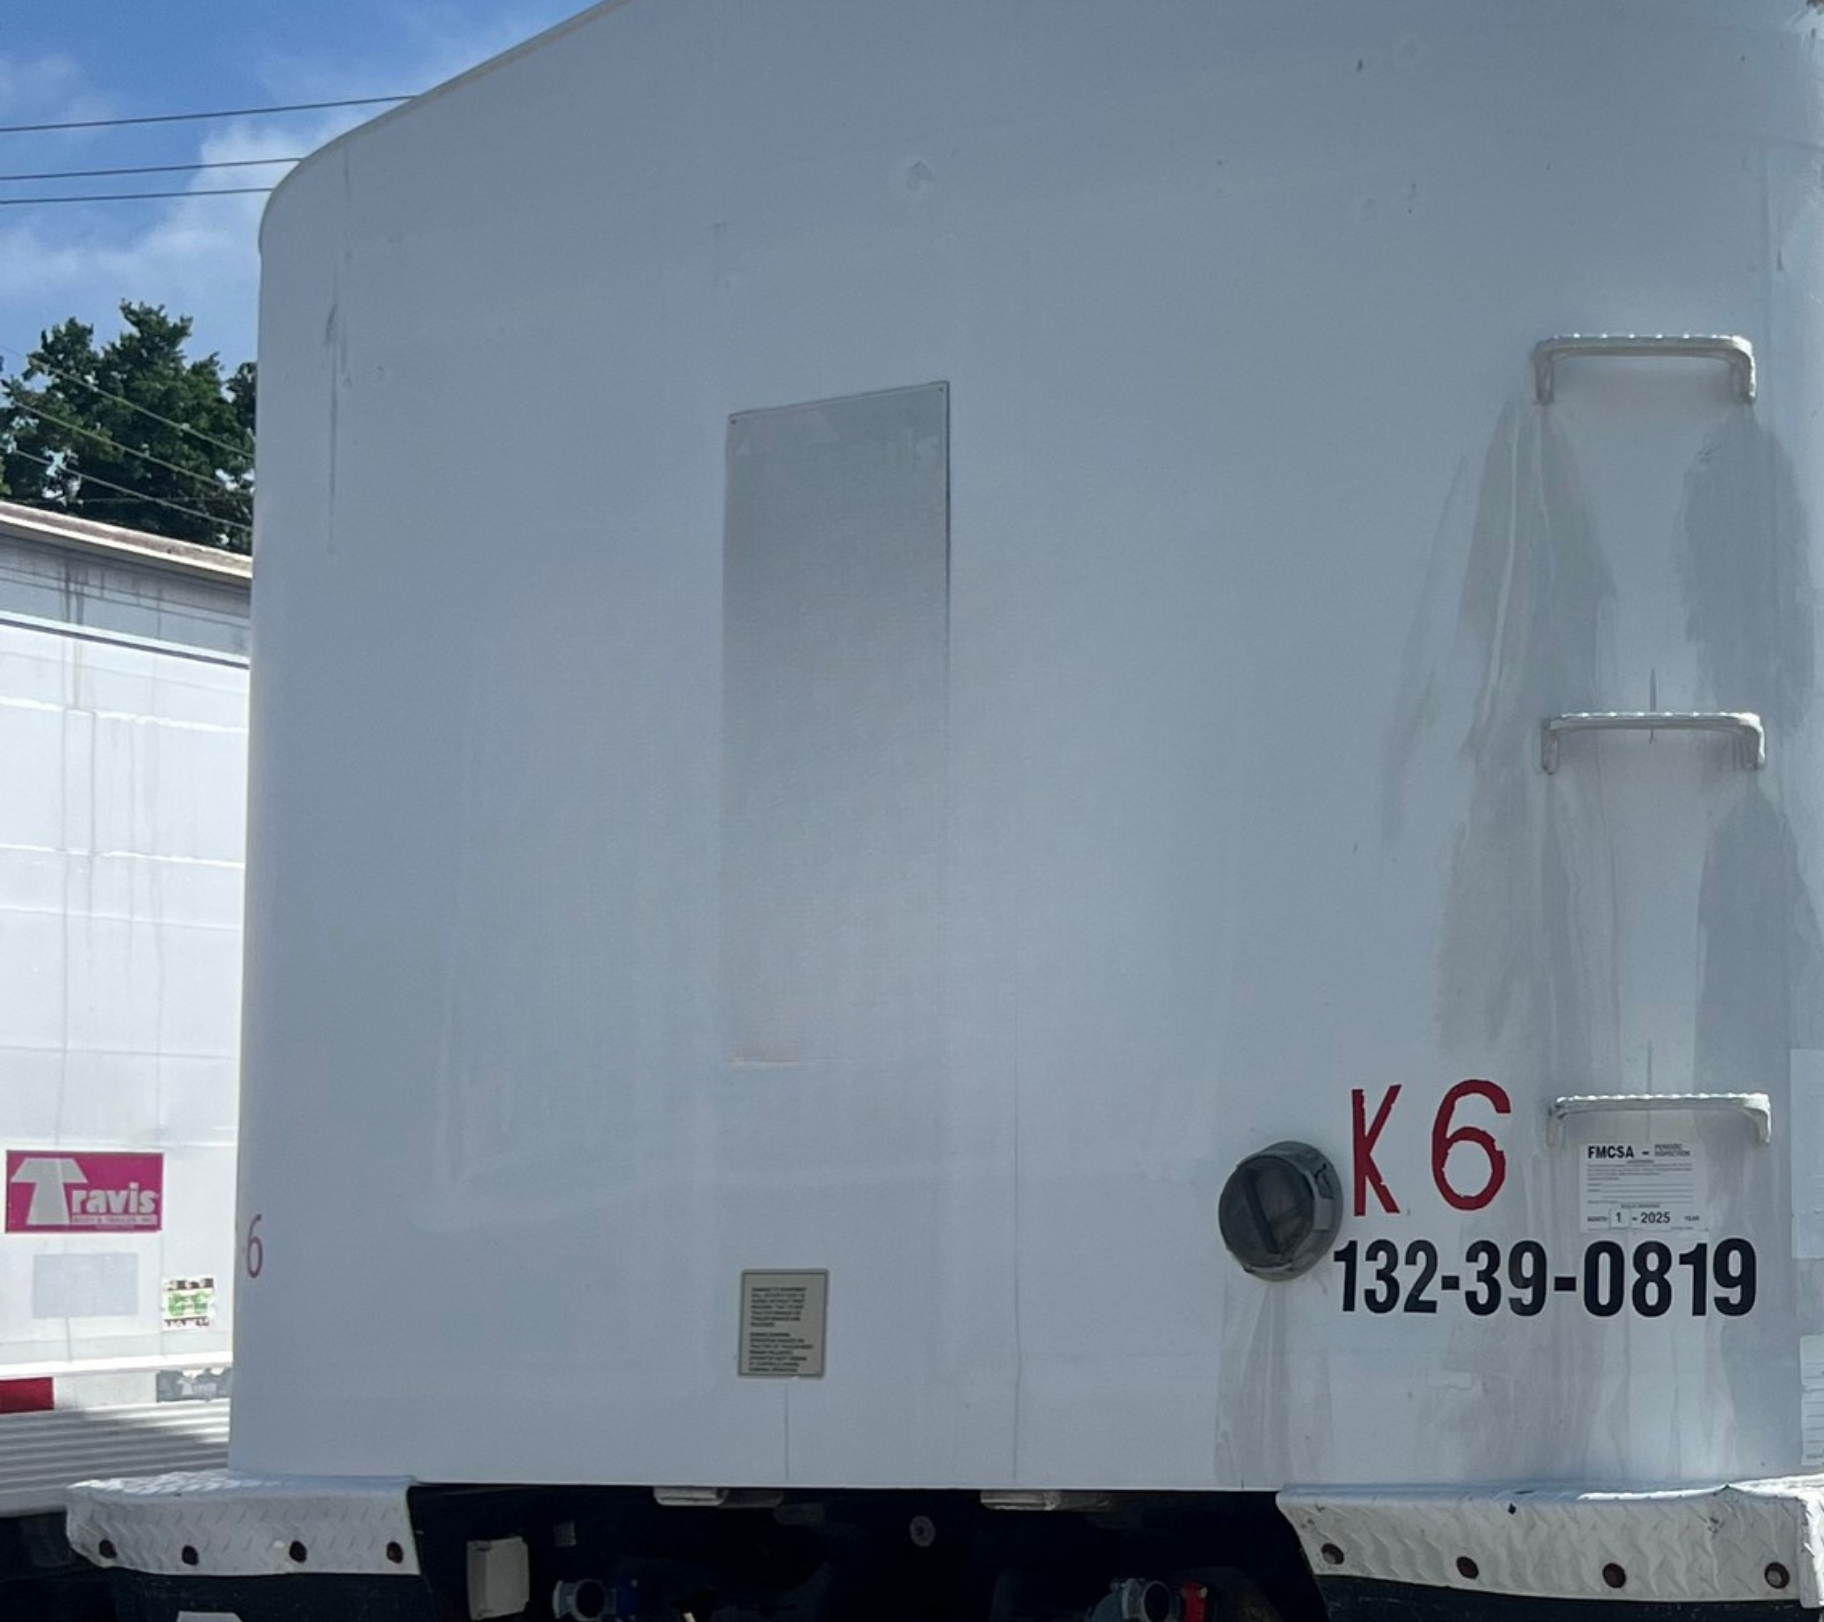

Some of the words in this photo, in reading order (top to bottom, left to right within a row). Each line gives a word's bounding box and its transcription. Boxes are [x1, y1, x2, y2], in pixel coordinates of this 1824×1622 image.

[1587, 1145, 1635, 1159] FMCSA
[10, 1157, 157, 1225] Travis
[1640, 1211, 1671, 1224] 2025
[247, 1213, 263, 1279] 6
[1332, 1239, 1758, 1317] 132-39-0819
